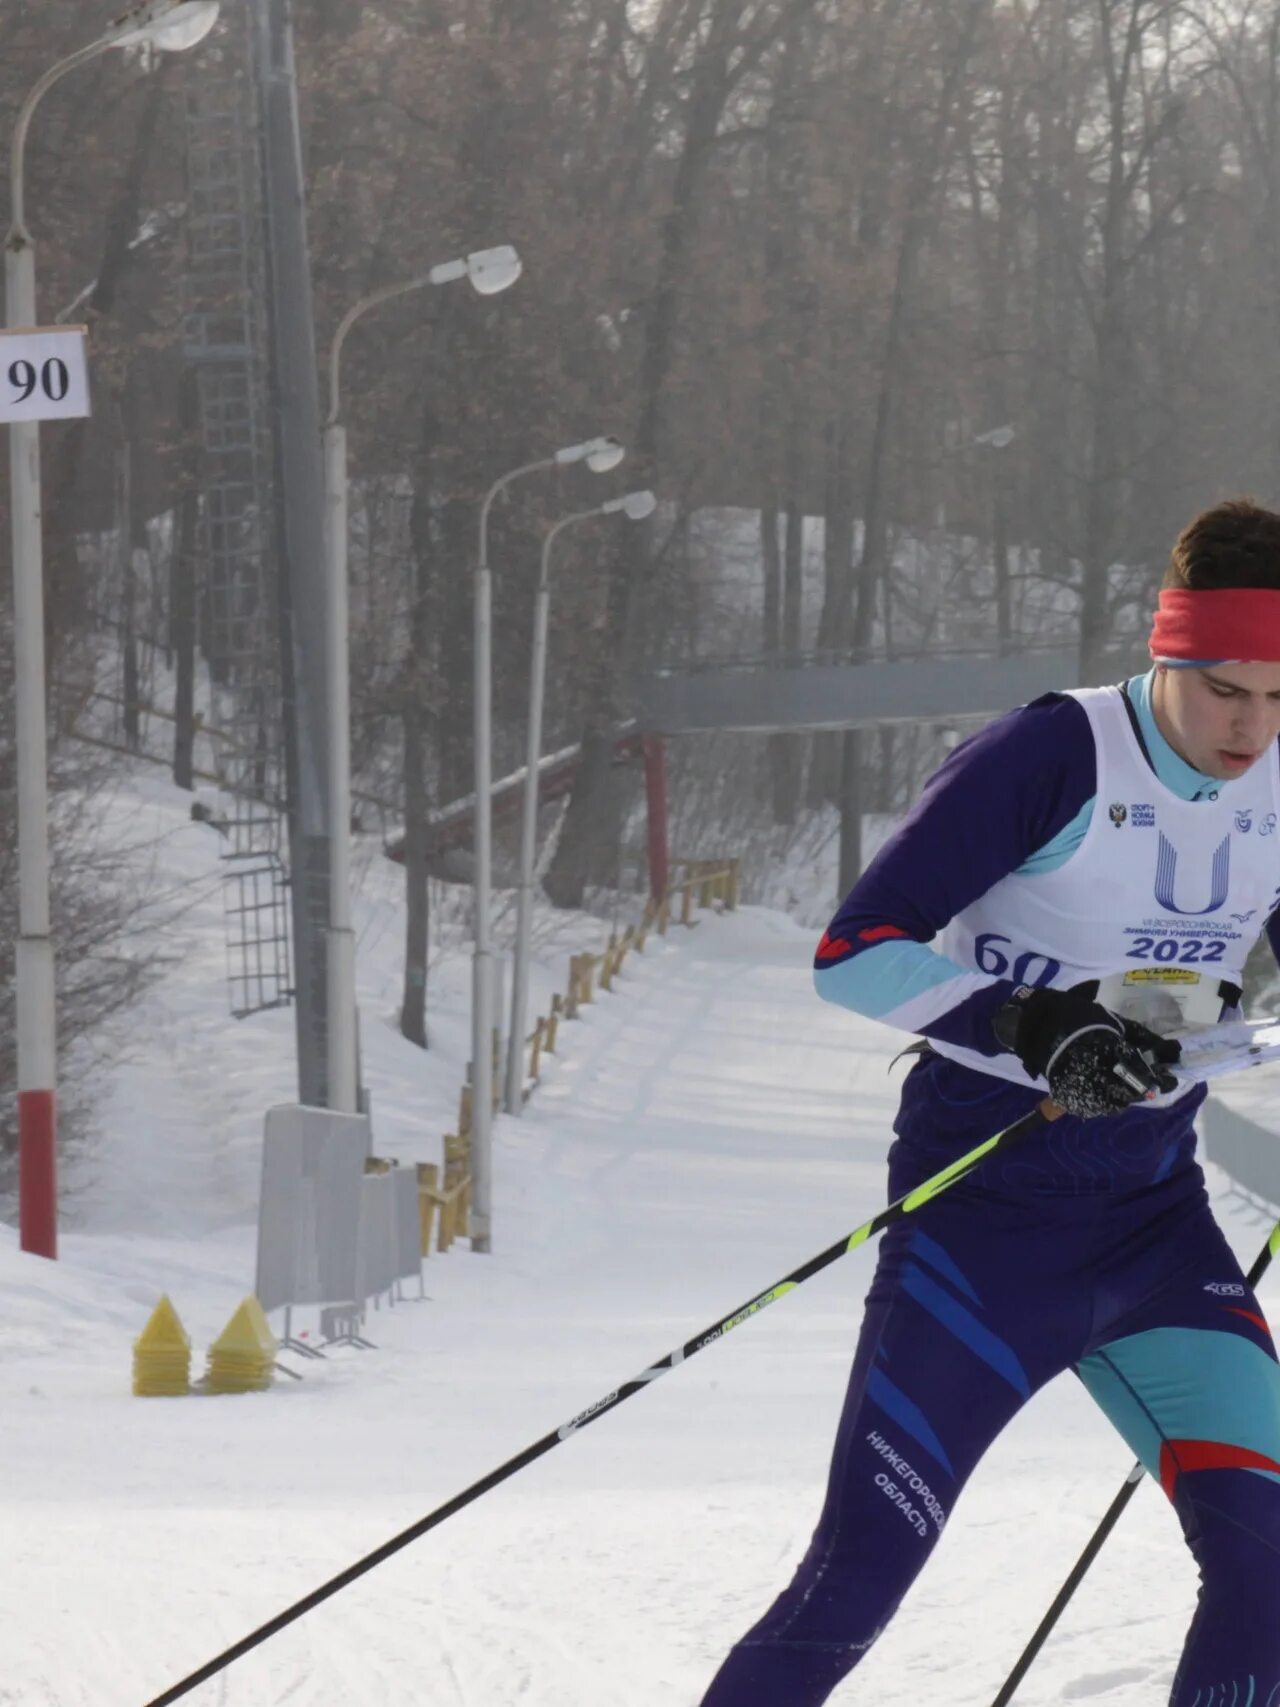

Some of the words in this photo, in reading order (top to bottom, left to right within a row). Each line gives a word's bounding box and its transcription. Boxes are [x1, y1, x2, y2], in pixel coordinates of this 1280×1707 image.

[8, 357, 69, 405] 90
[1122, 927, 1168, 937] ЗИМНЯЯ
[1169, 929, 1243, 940] УНИВЕРСИАДА
[1154, 918, 1233, 930] ВСЕРОССИЙСКАЯ
[974, 933, 1061, 988] 60
[1125, 937, 1227, 963] 2022
[874, 1473, 928, 1537] ОБЛАСТЬ
